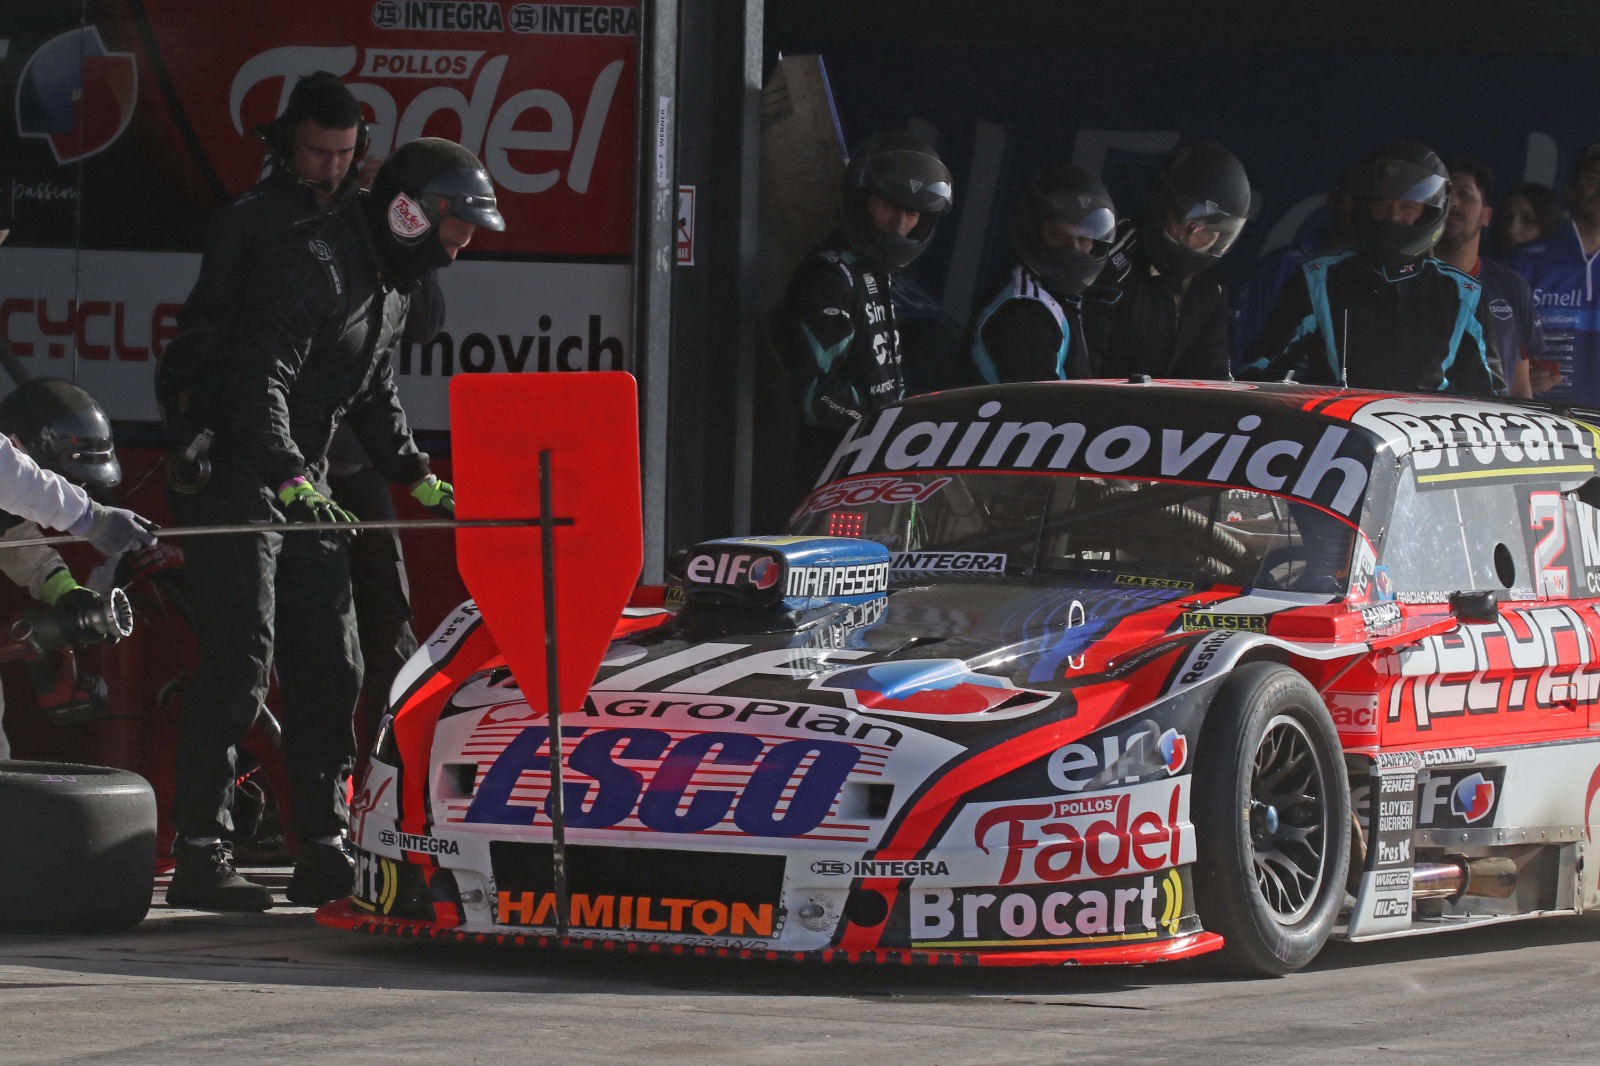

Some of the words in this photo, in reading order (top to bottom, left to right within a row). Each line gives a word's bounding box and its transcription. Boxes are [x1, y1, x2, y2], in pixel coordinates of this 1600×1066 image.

[404, 2, 503, 31] INTEGRA
[541, 7, 638, 34] INTEGRA
[372, 54, 468, 75] POLLOS
[10, 180, 79, 219] passion
[396, 198, 425, 230] Fadel
[1532, 288, 1582, 307] Smell
[1384, 413, 1594, 470] Brocart
[813, 400, 1368, 516] Haimovich
[790, 478, 951, 522] Fadel
[1528, 491, 1570, 599] 2
[687, 553, 750, 585] elf
[896, 553, 1004, 571] INTEGRA
[785, 561, 889, 601] MANASSERO
[1115, 574, 1193, 589] KAESER
[1396, 591, 1426, 604] GRACIAS
[430, 616, 466, 647] S.R.L.
[1184, 613, 1266, 629] KAESER
[588, 642, 876, 694] lf
[1389, 604, 1600, 730] RECYCL
[1424, 747, 1477, 766] COLLINO
[465, 726, 862, 838] ESCO
[1381, 780, 1415, 794] PEHUEN
[1060, 799, 1113, 816] POLLOS
[1380, 801, 1399, 816] ELOY
[399, 833, 460, 856] INTEGRA
[974, 783, 1182, 886] Fadel
[854, 860, 950, 877] INTEGRA
[498, 891, 773, 936] HAMILTON
[910, 875, 1158, 940] Brocart
